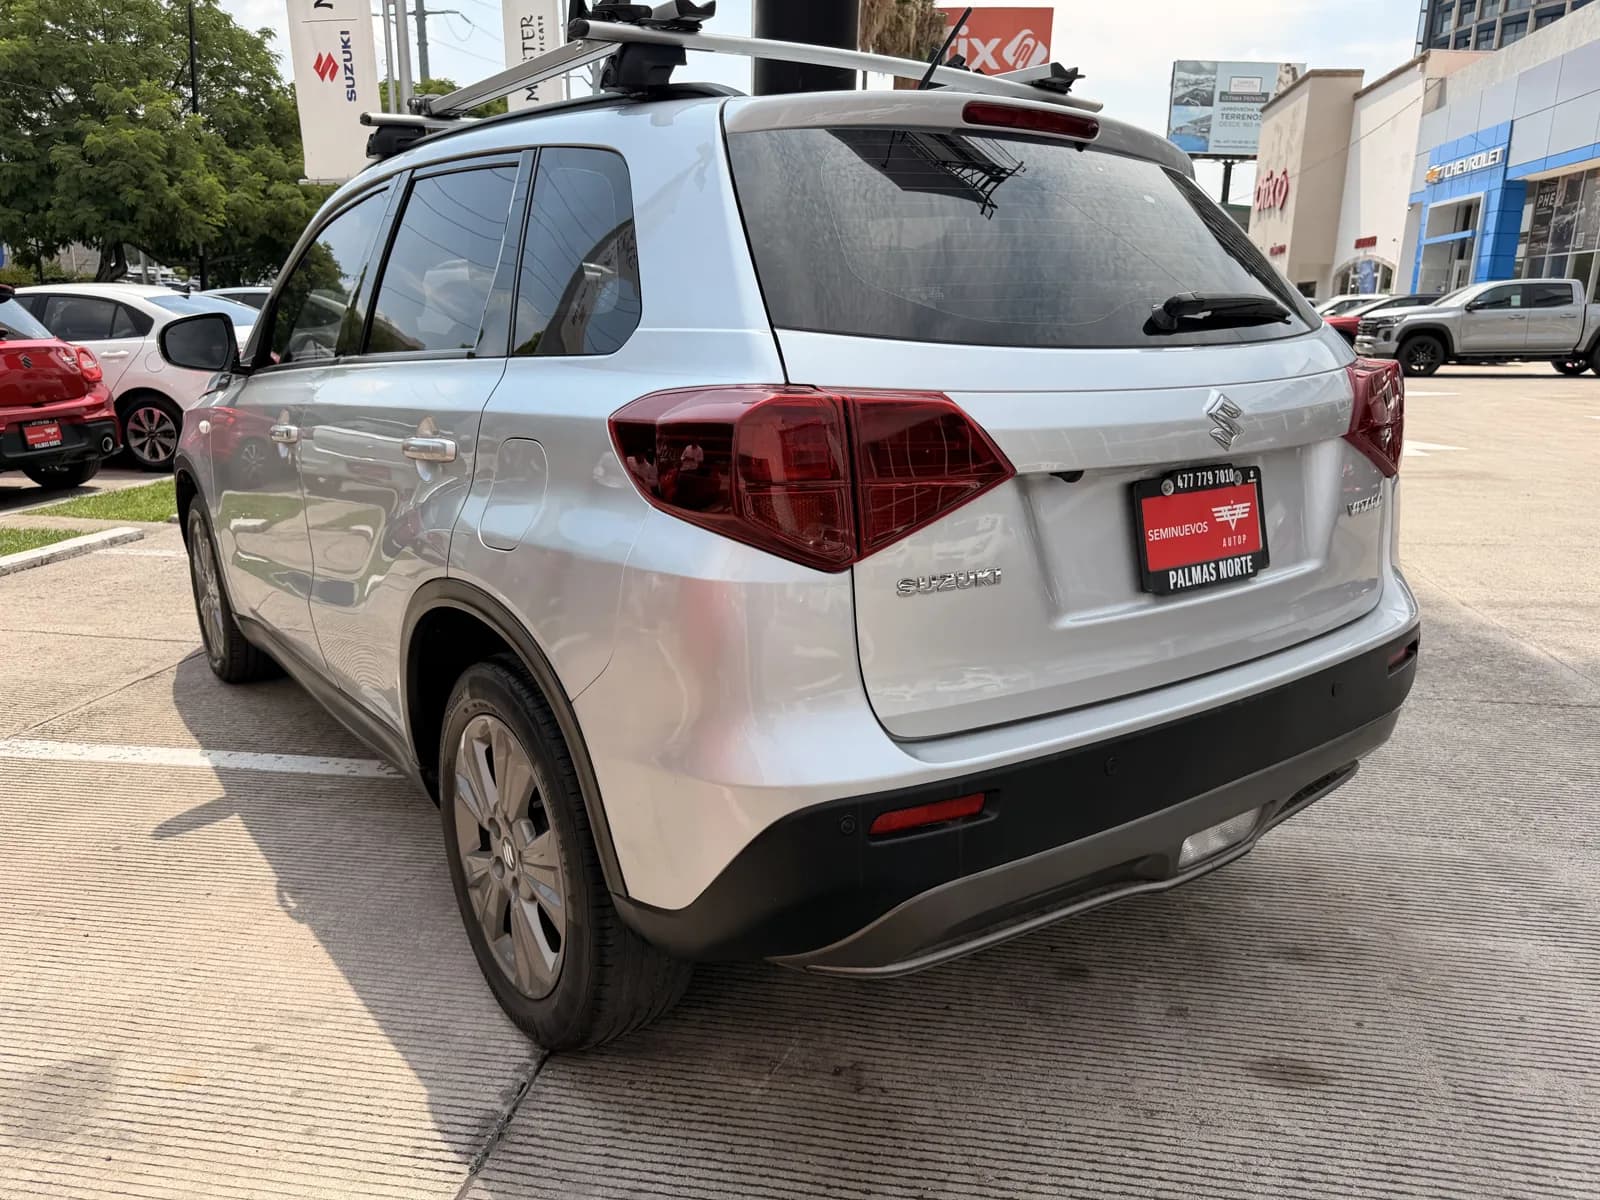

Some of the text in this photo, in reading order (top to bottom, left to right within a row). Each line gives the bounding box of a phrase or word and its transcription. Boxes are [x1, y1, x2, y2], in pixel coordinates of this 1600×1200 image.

[339, 30, 357, 102] SUZUKI
[521, 15, 540, 101] MTER
[1444, 147, 1505, 178] CHEVROLET
[1177, 468, 1234, 489] 477 779 7010
[1148, 521, 1209, 542] SEMINUEVOS
[896, 568, 1001, 597] SUZUKI
[1168, 555, 1254, 590] PALMAS NORTE
